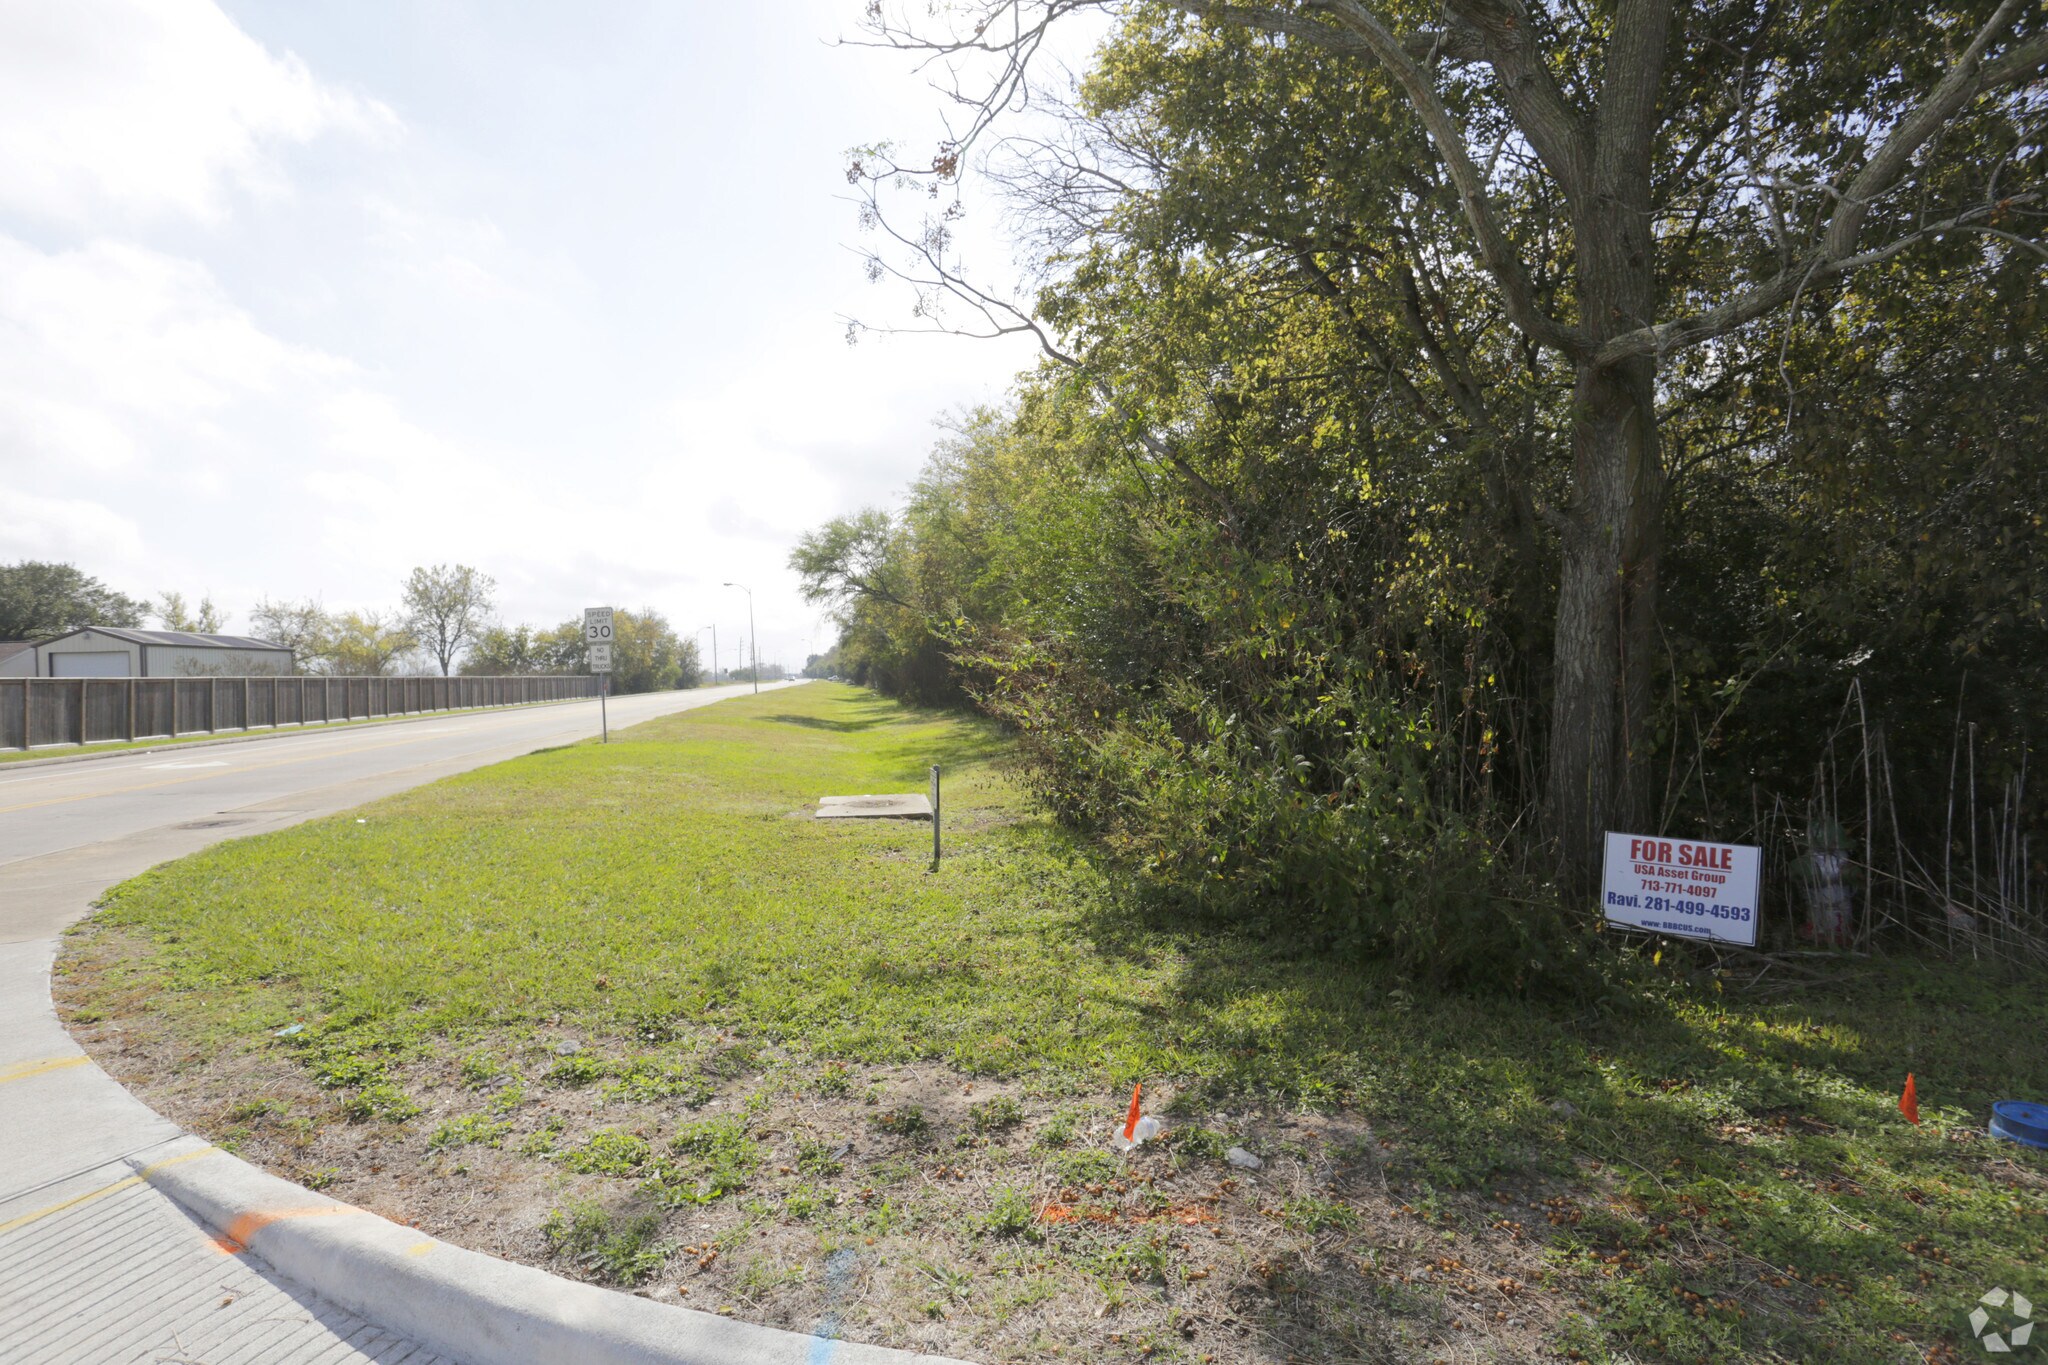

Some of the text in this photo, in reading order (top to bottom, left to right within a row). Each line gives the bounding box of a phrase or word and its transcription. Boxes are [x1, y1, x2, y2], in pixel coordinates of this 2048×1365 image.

[589, 626, 611, 638] 30
[1631, 839, 1732, 870] FOR SALE
[1634, 864, 1726, 884] USA Asset Group
[1641, 879, 1717, 898] 713-771-4097
[1607, 892, 1751, 921] Ravi. 281-499-4593
